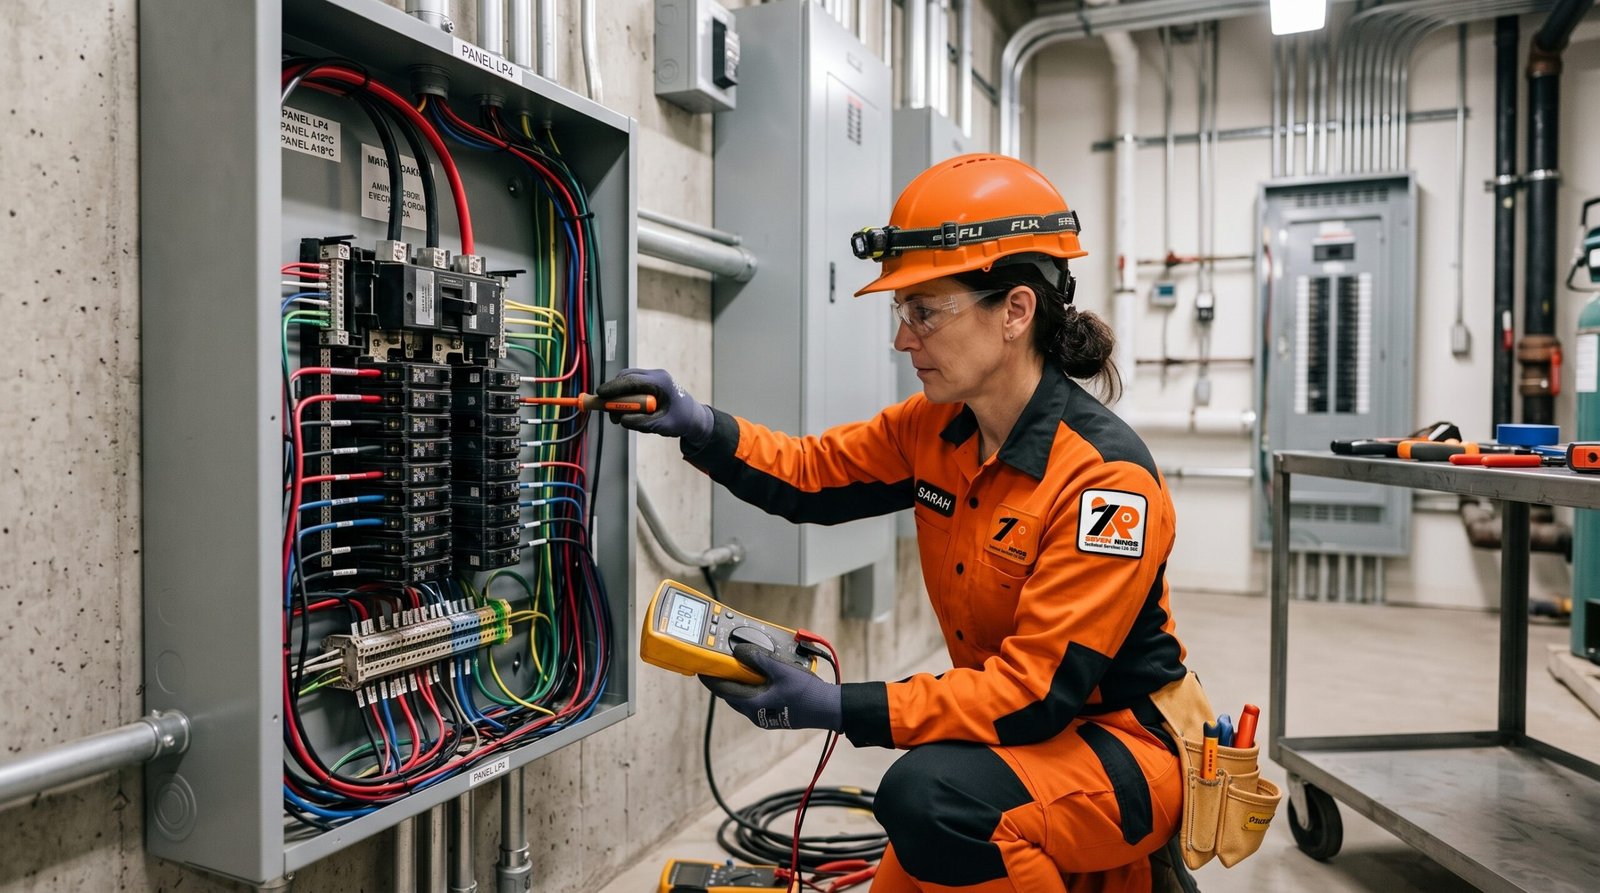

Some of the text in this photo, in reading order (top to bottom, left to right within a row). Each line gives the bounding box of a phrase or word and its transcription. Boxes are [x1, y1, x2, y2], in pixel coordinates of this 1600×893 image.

[462, 44, 514, 78] PANEL LP4
[281, 121, 310, 138] PANEL
[282, 109, 329, 131] PANEL LP4
[281, 134, 310, 151] PANEL
[917, 486, 952, 511] SARAH
[473, 767, 494, 782] PANEL
